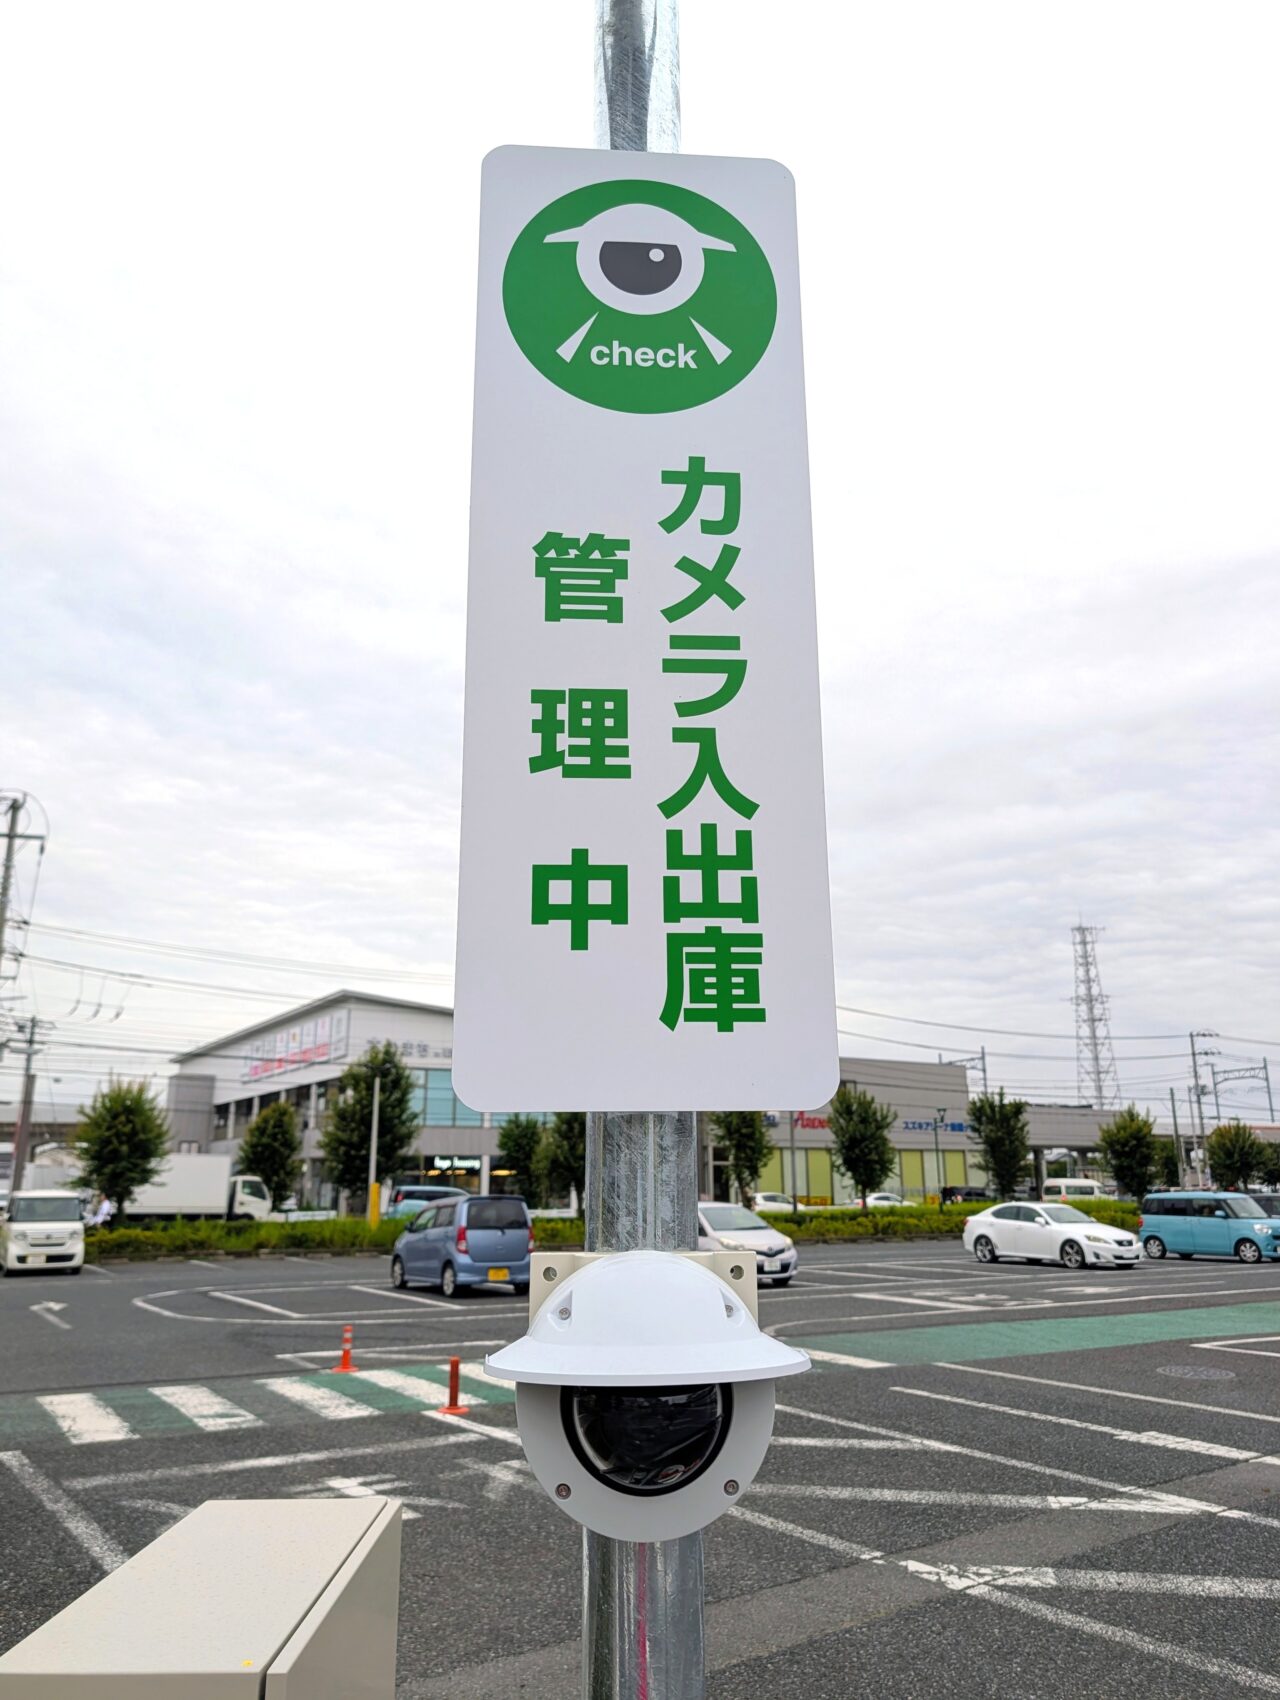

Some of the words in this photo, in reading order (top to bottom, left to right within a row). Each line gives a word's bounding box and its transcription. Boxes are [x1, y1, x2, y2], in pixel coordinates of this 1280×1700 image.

[590, 340, 698, 369] check
[529, 531, 631, 951] 管理中
[658, 456, 766, 1033] カメラ入出庫
[793, 1111, 832, 1130] AREN
